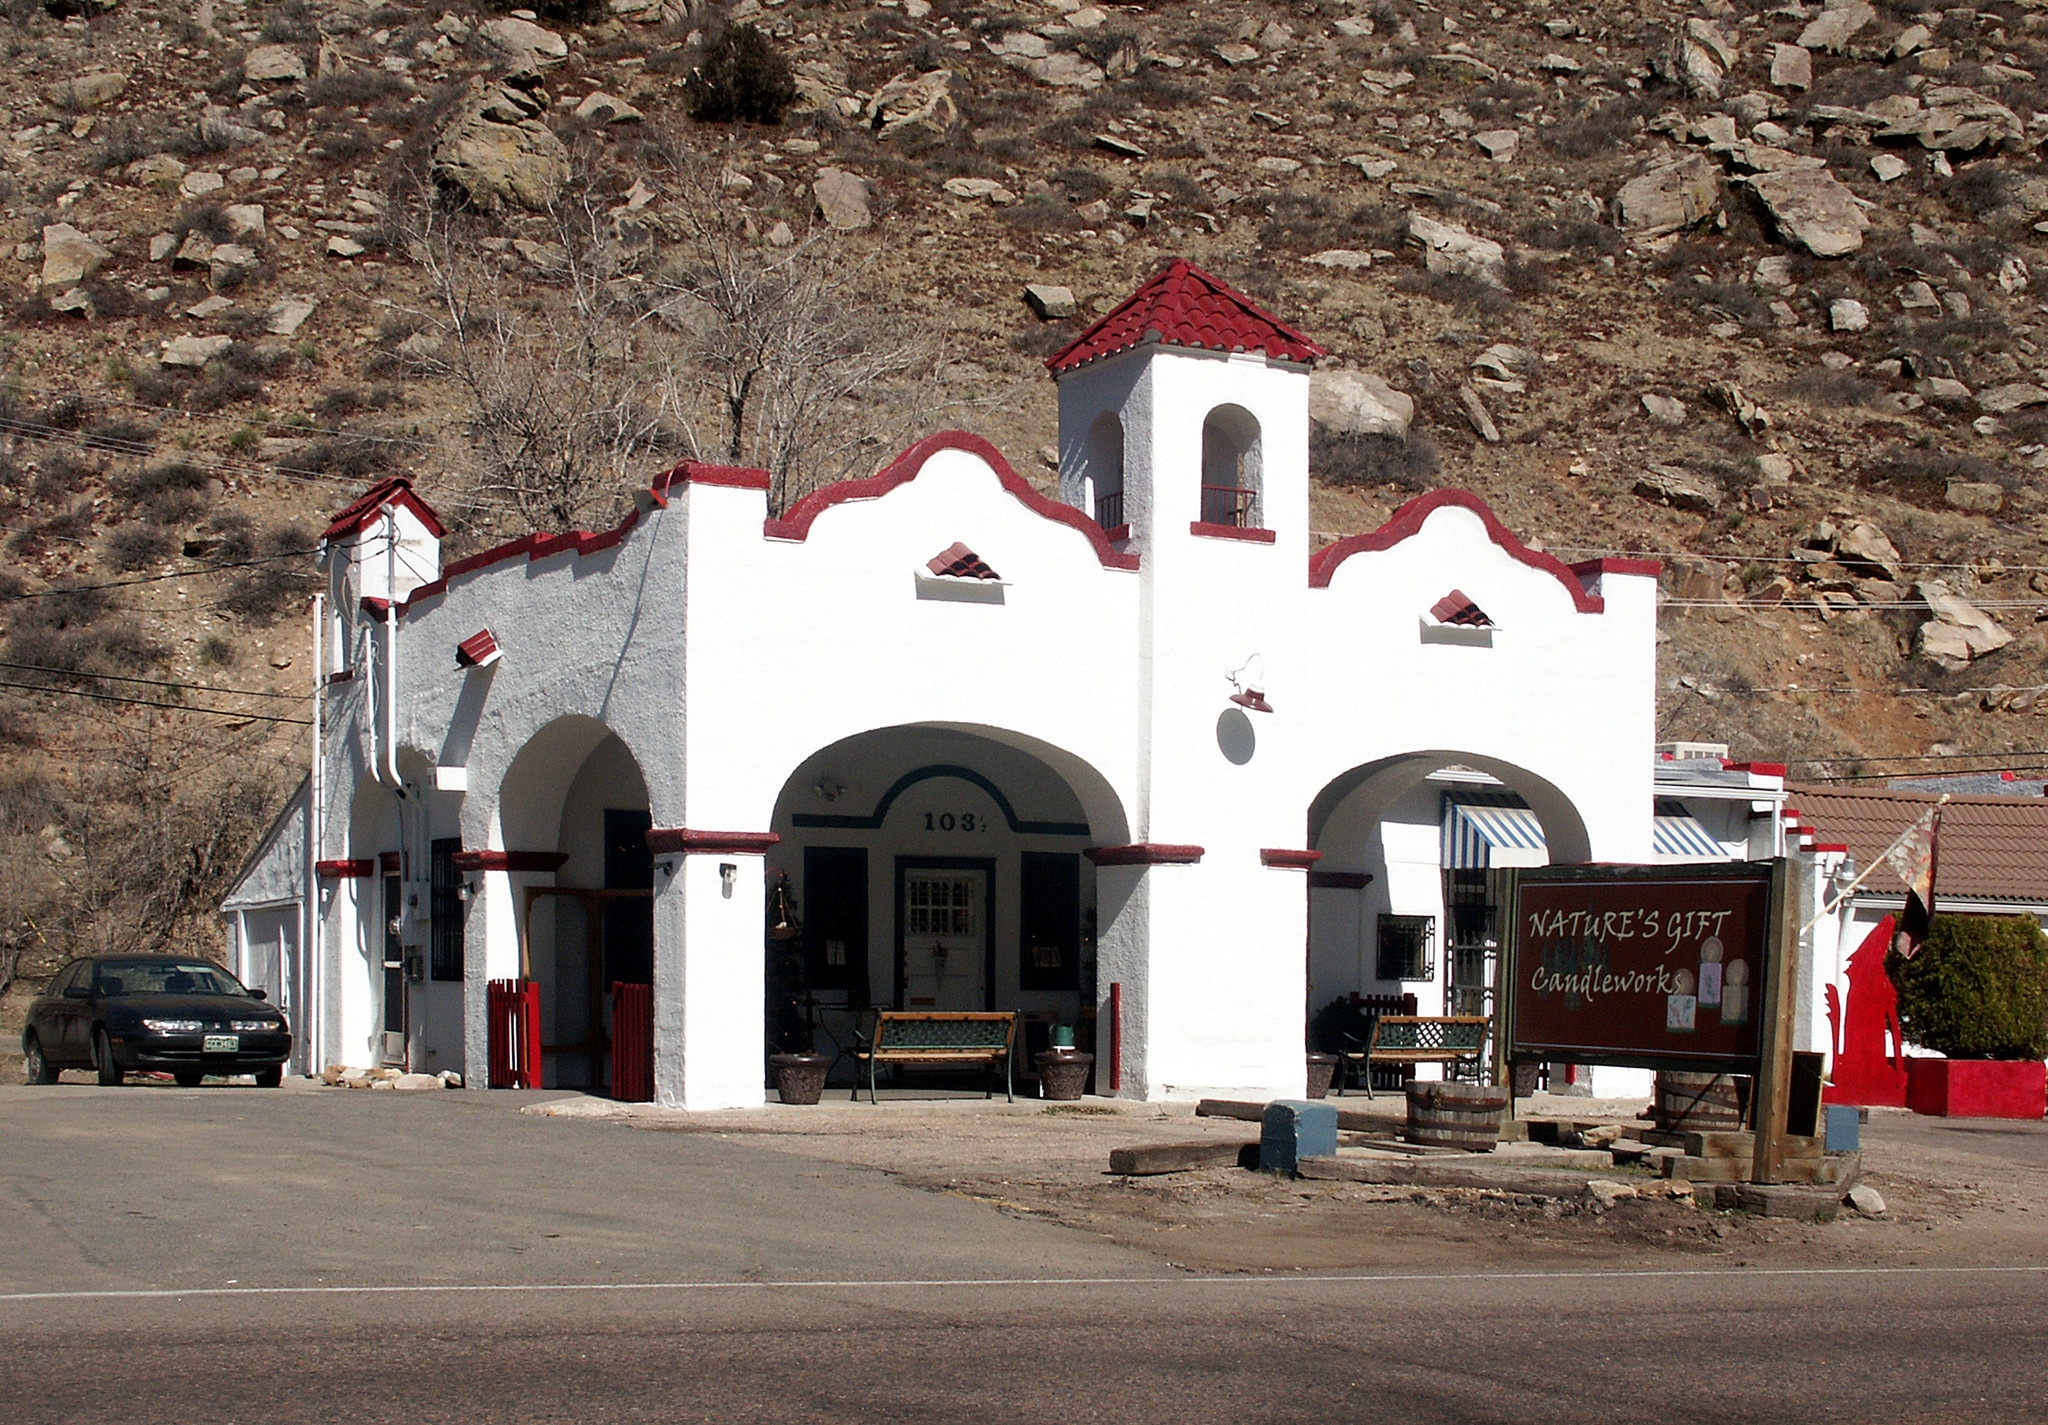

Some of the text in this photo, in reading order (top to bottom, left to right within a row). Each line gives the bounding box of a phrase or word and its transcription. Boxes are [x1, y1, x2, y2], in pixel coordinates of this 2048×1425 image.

[1528, 908, 1732, 954] NATURE'S GIFT
[1531, 964, 1682, 1002] Candleworks
